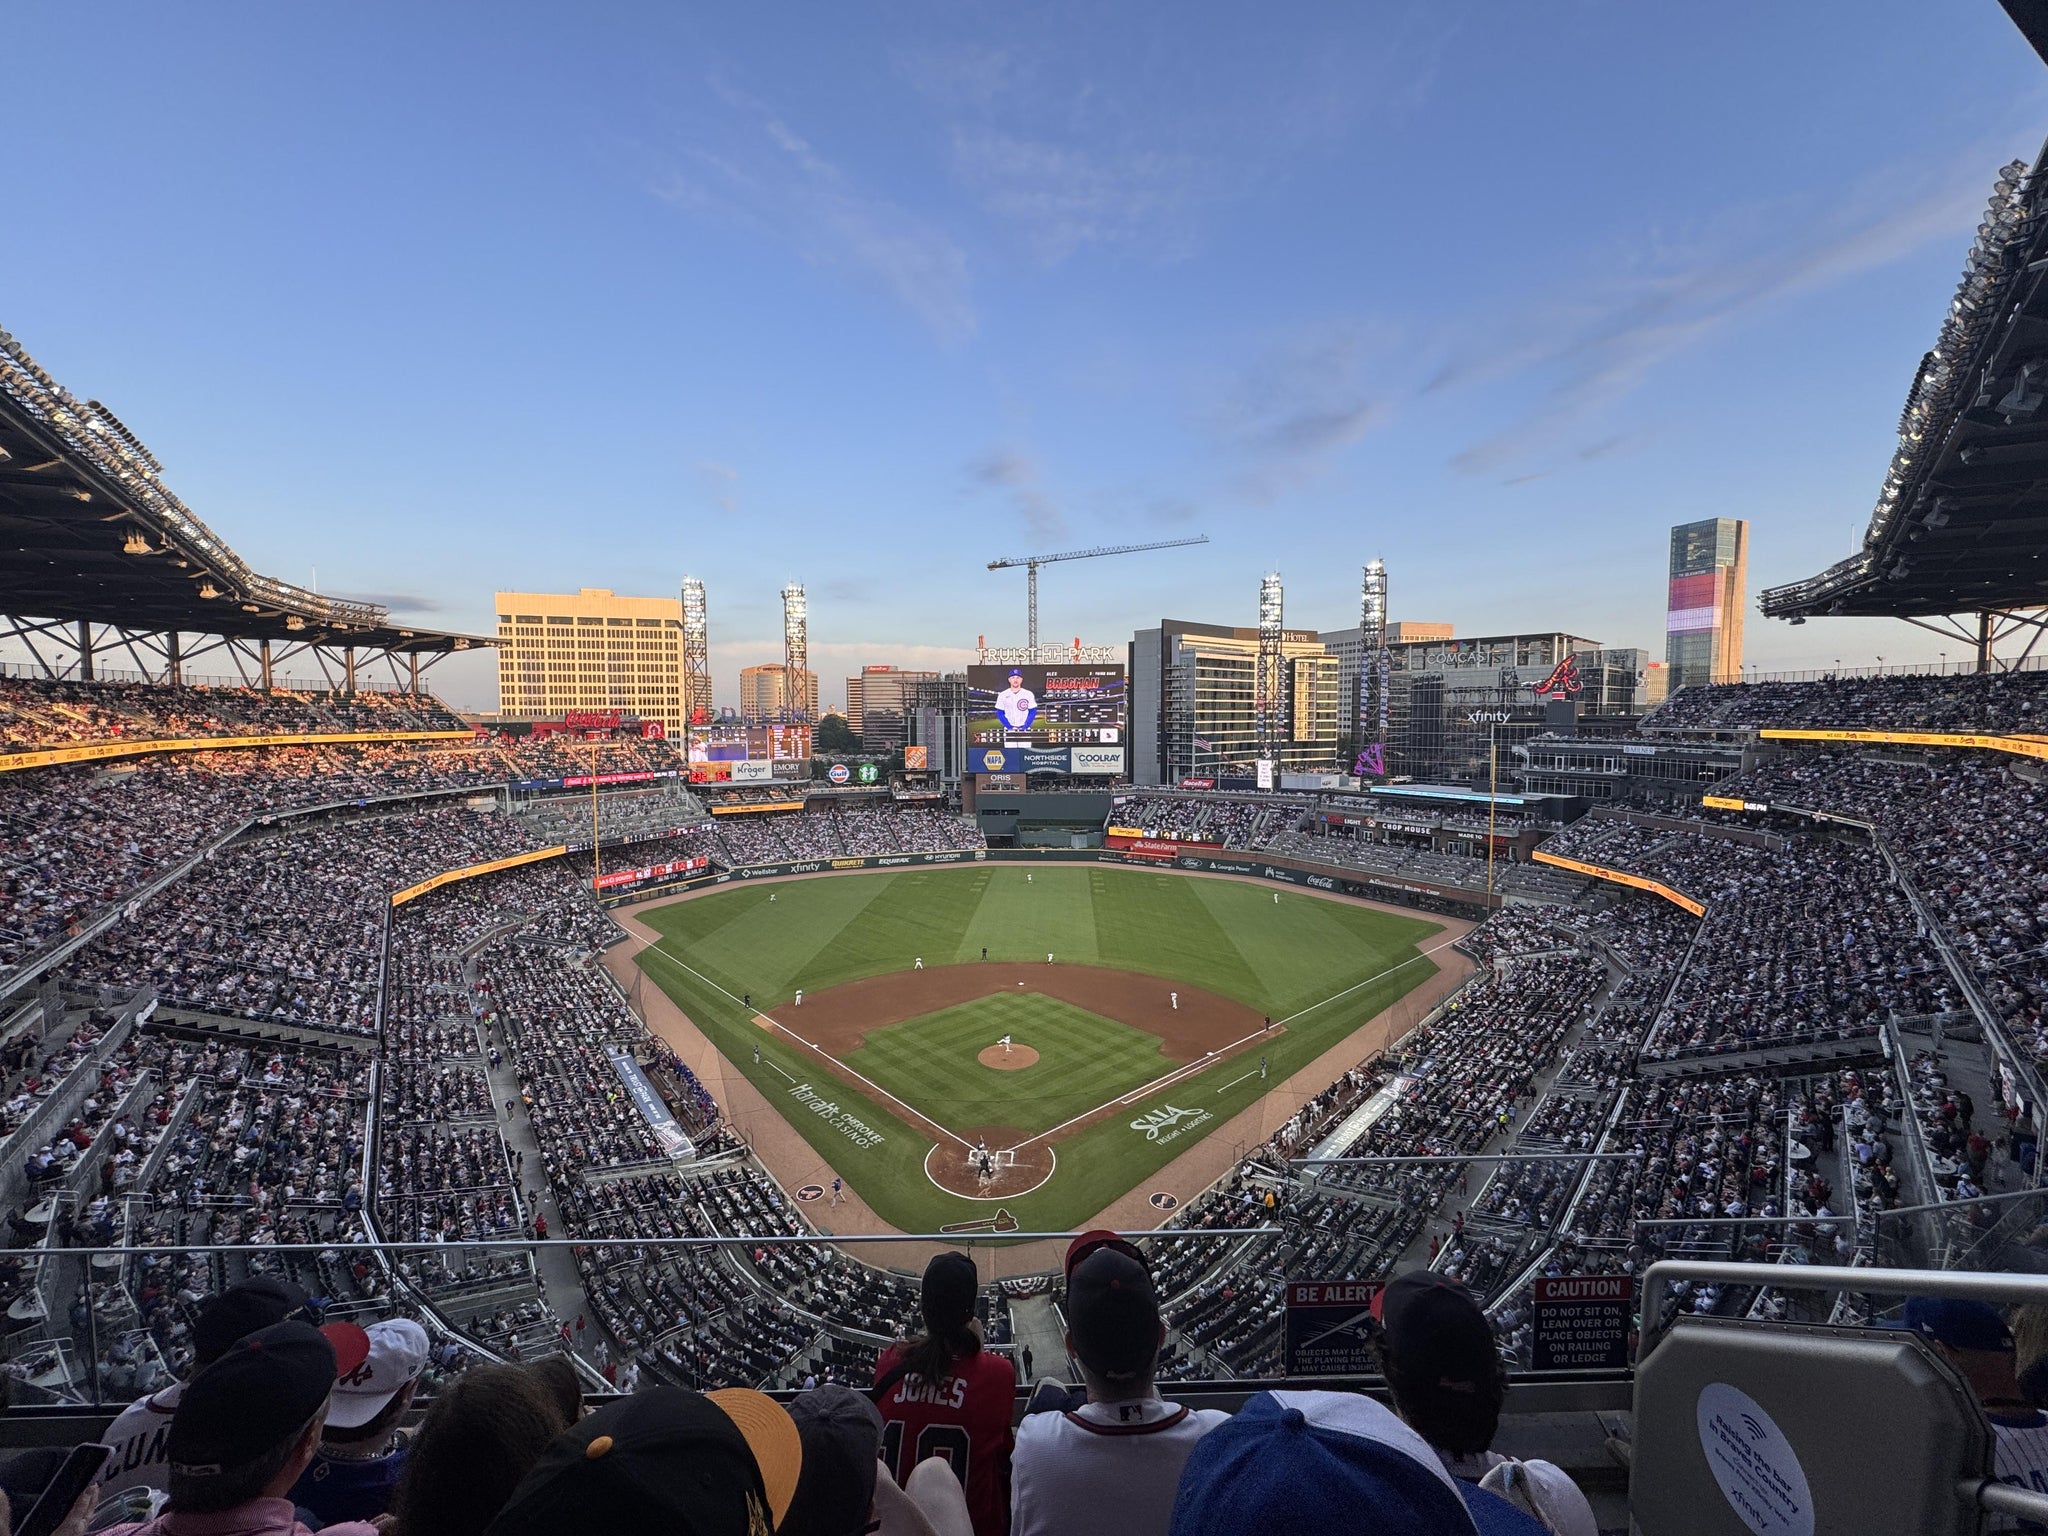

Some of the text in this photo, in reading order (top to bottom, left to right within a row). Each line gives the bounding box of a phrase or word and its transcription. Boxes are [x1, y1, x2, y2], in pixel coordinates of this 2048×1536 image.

[1286, 632, 1309, 642] HOTEL
[975, 646, 1114, 661] TRUIST PARK
[1428, 651, 1491, 664] COMCAST
[1046, 677, 1100, 690] BREGMAN
[565, 709, 622, 729] Coca-Cola
[1467, 709, 1511, 724] xfinity
[986, 754, 1003, 765] NAPA
[1078, 754, 1121, 762] COOLRAY
[737, 763, 766, 777] Kroger
[773, 763, 800, 771] EMORY
[1344, 818, 1361, 826] LIGHT
[1382, 822, 1431, 835] CHOP HOUSE
[1144, 841, 1160, 850] State
[831, 858, 866, 868] QUIKRETE
[878, 857, 910, 866] EQUIFAX
[751, 868, 778, 876] Wellstar
[790, 862, 820, 874] xfinity
[1216, 864, 1235, 872] Georgia
[1306, 874, 1334, 888] Coca-Cola
[1130, 1104, 1205, 1140] SAIA
[828, 1117, 875, 1149] CASINOS
[840, 1112, 885, 1145] CHEROKEE
[1155, 1112, 1214, 1146] FREIGHT LOGISTICS
[1296, 1285, 1378, 1302] BE ALERT
[1545, 1280, 1621, 1298] CAUTION
[1541, 1306, 1622, 1318] DO NOT SIT ON,
[1542, 1318, 1620, 1329] LEAN OVER OR
[1539, 1329, 1623, 1341] PLACE OBJECTS
[1295, 1348, 1330, 1357] OBJECTS
[1332, 1348, 1349, 1356] MAY
[1549, 1341, 1611, 1352] ON RAILING
[1297, 1357, 1313, 1365] THE
[1314, 1356, 1348, 1364] PLAYING
[1552, 1353, 1607, 1364] OR LEDGE
[1293, 1365, 1300, 1373] &
[1301, 1364, 1318, 1372] MAY
[1320, 1364, 1347, 1372] CAUSE
[893, 1372, 968, 1409] JONES
[1716, 1414, 1793, 1492] Raising the bar
[1709, 1418, 1799, 1514] in Braves Country
[1731, 1486, 1768, 1529] xfinity
